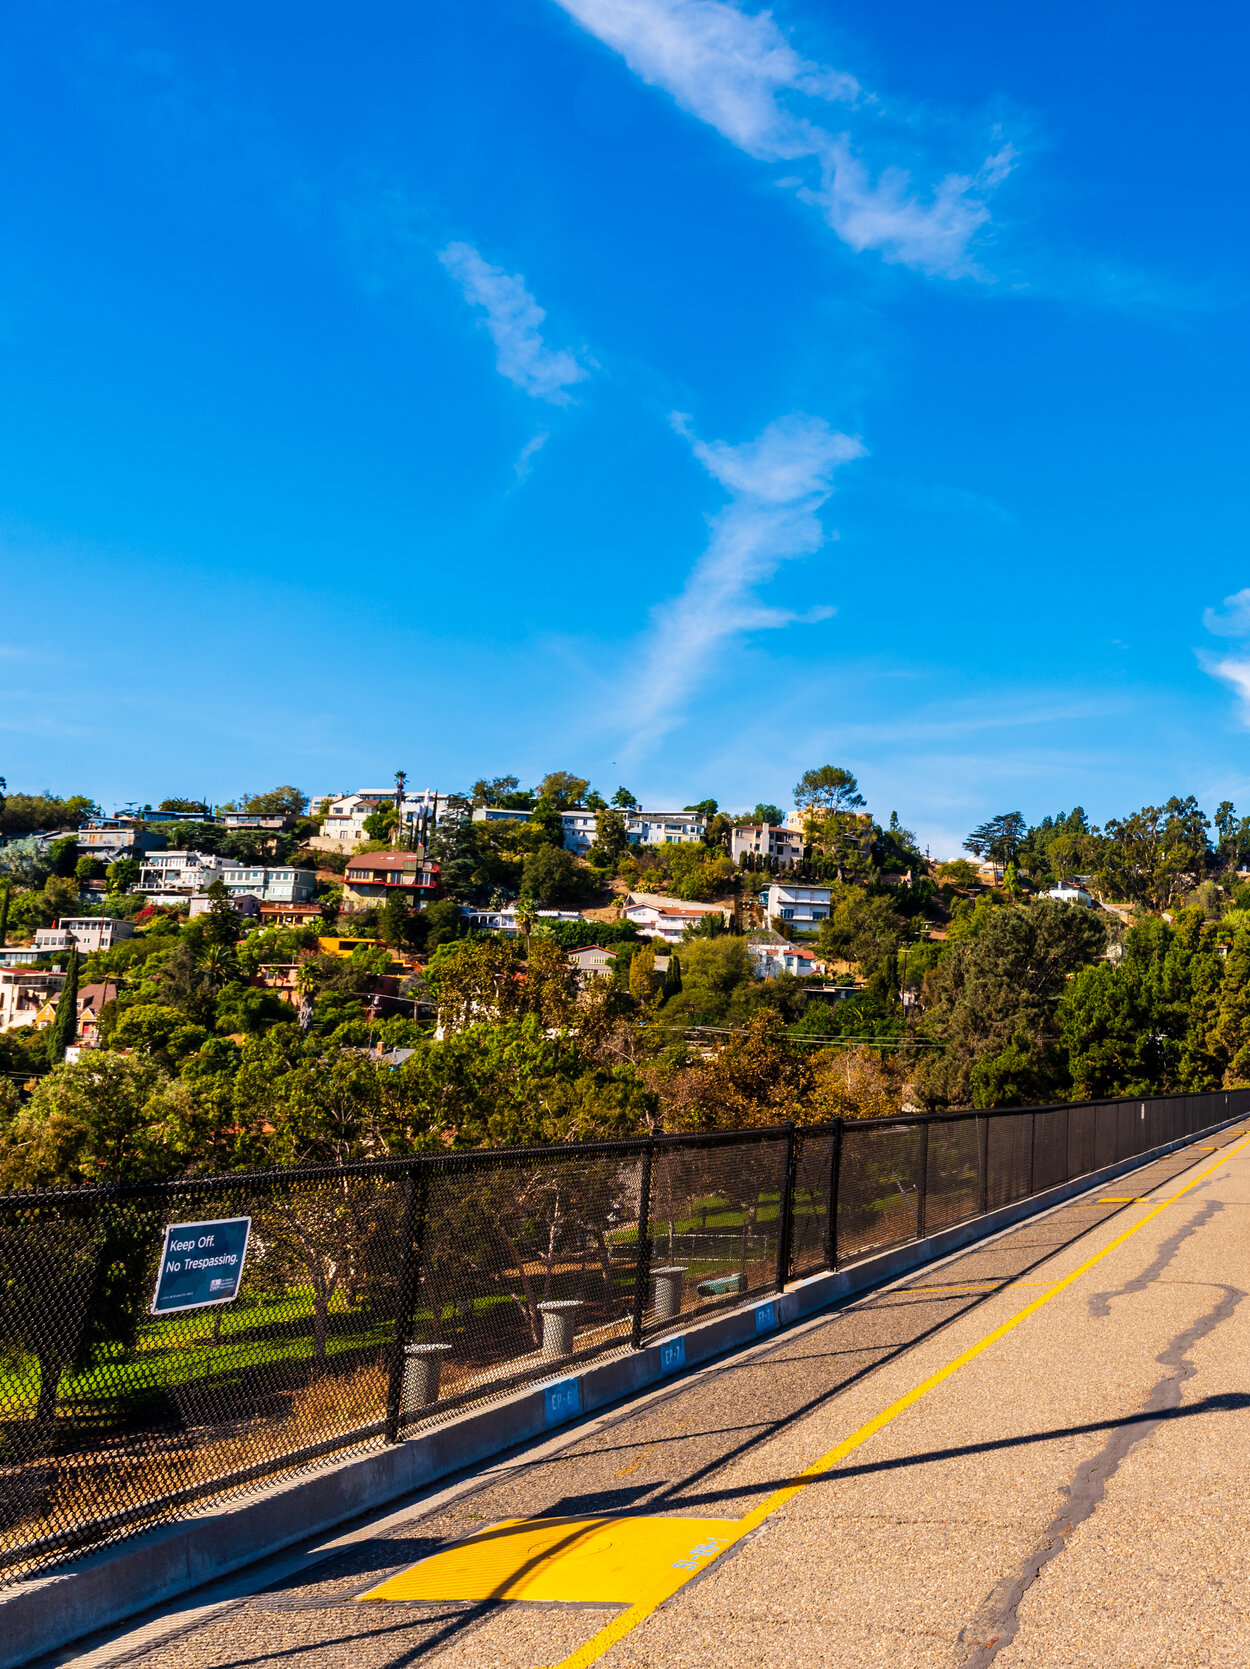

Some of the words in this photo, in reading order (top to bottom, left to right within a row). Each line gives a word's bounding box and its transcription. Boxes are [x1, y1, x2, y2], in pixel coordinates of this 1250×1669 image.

[169, 1239, 195, 1252] Keep
[197, 1235, 215, 1248] Off.
[165, 1260, 181, 1273] No
[184, 1253, 239, 1270] Trespassing.
